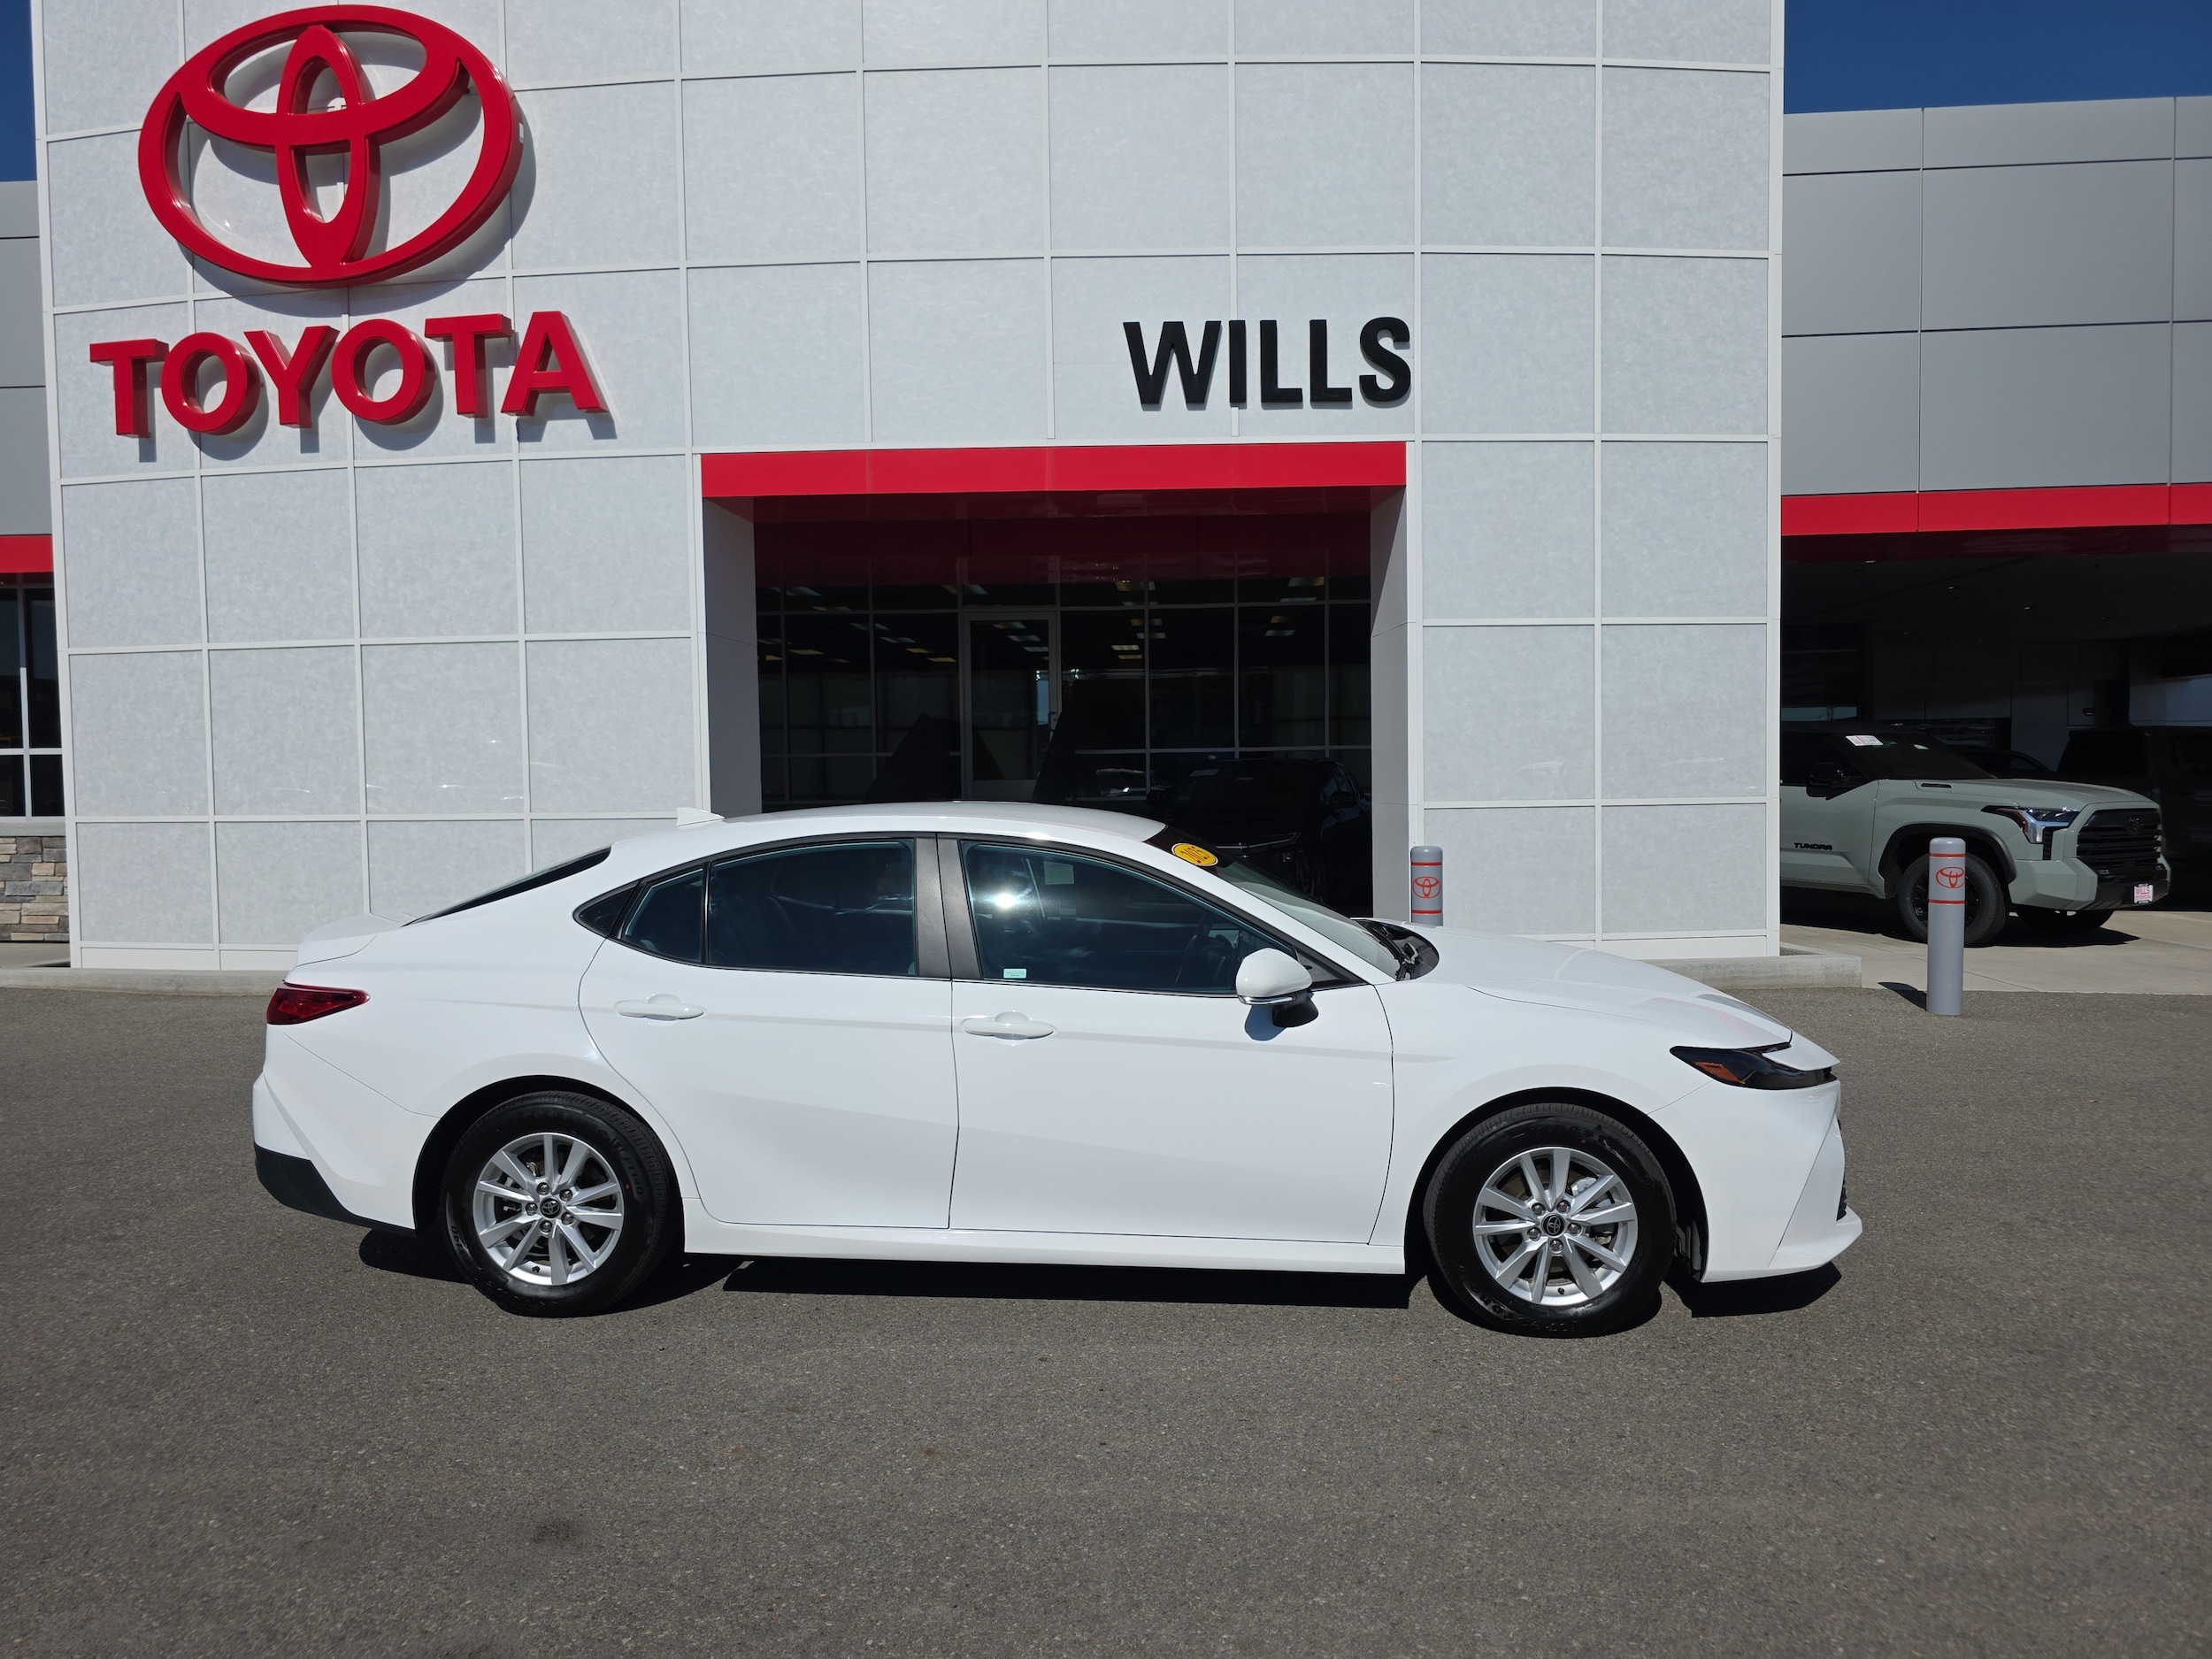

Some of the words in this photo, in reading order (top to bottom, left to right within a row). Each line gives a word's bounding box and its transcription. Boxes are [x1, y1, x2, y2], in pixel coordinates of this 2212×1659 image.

[89, 311, 609, 438] TOYOTA
[1123, 317, 1411, 404] WILLS
[1793, 842, 1832, 851] TUNDRA
